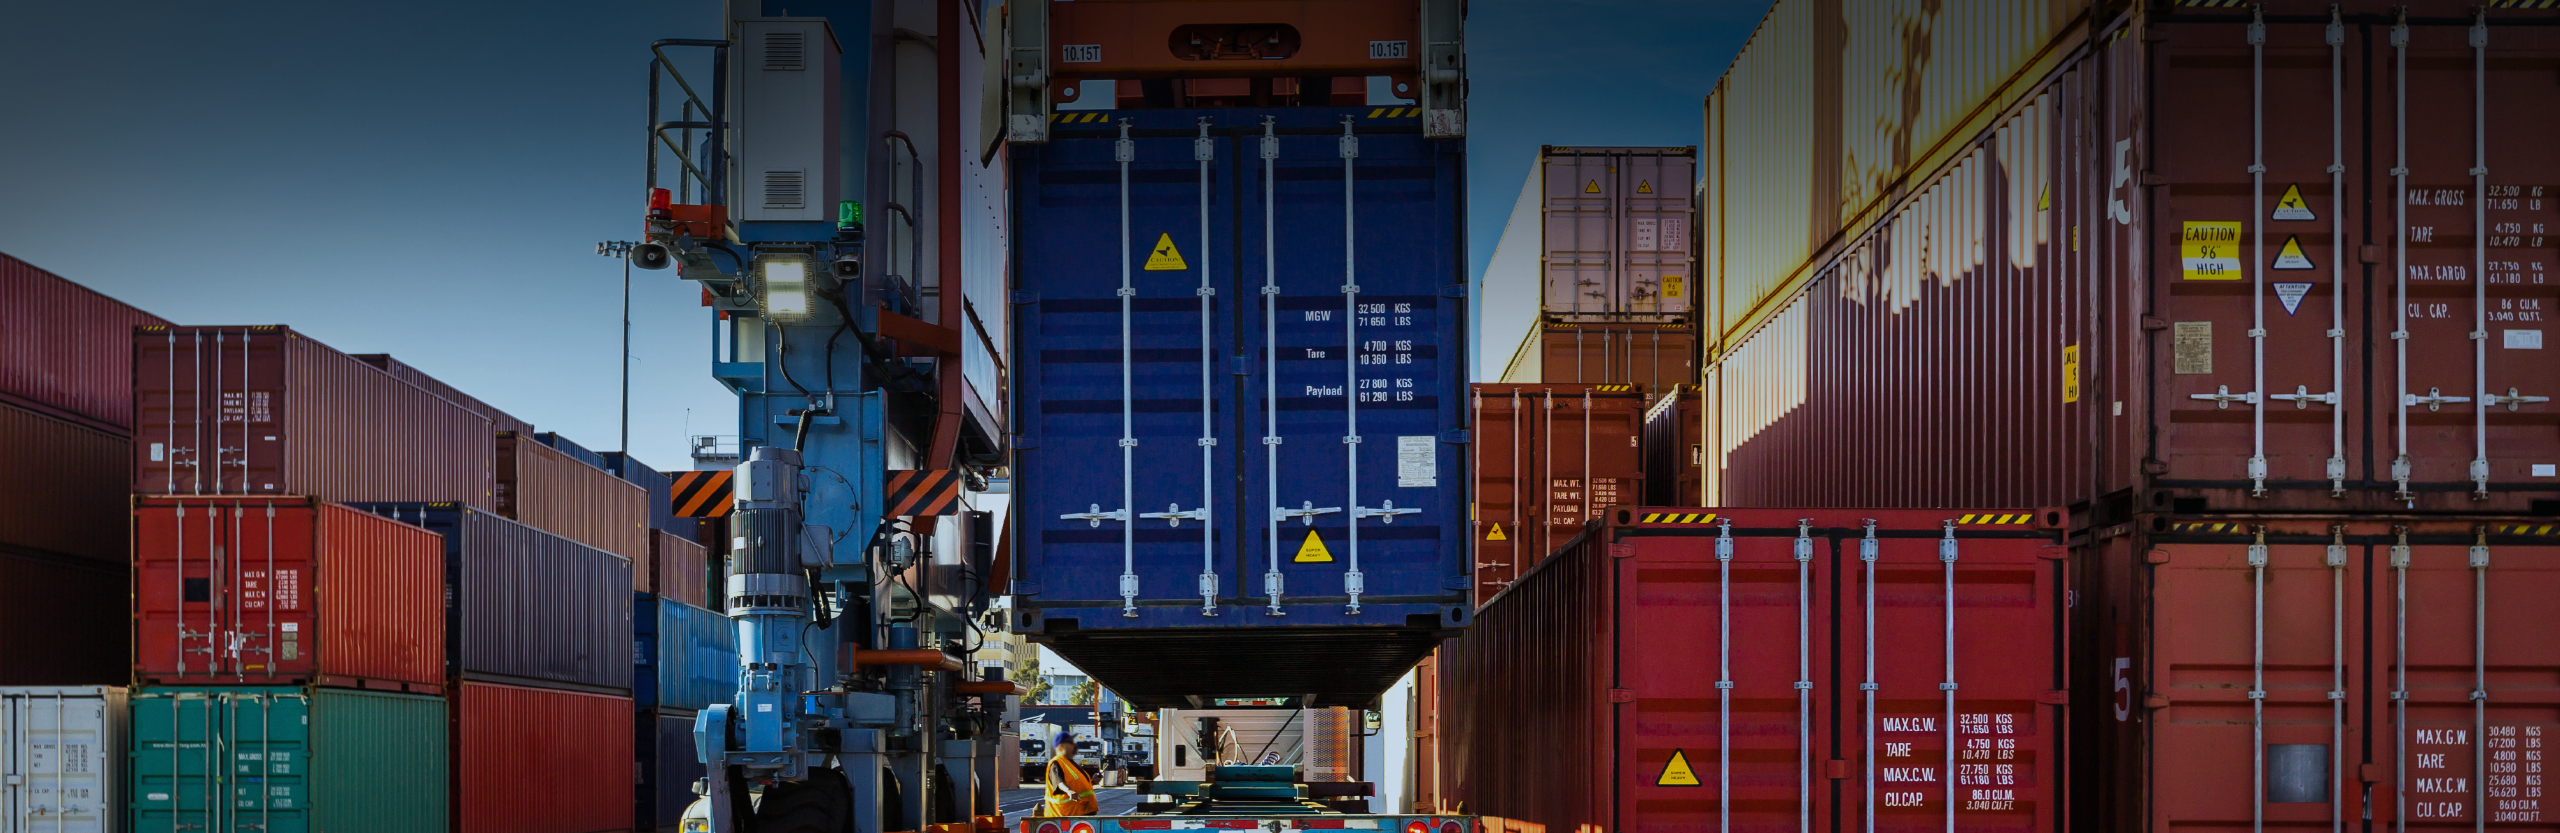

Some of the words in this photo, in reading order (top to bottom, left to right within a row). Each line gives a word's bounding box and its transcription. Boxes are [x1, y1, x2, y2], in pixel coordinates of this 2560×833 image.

[1064, 46, 1099, 60] 10.15T
[1371, 42, 1406, 57] 10.15T
[2488, 185, 2520, 197] 32.500
[2531, 186, 2543, 197] KG
[2408, 189, 2431, 205] MAX.
[2435, 189, 2465, 206] GROSS
[2487, 199, 2518, 210] 71.650
[2530, 199, 2541, 210] LB
[2186, 227, 2235, 241] CAUTION
[2411, 226, 2433, 242] TARE
[2495, 223, 2521, 234] 4.750
[2533, 223, 2544, 234] KG
[2489, 236, 2520, 247] 10.470
[2531, 236, 2543, 247] LB
[2197, 263, 2224, 275] HIGH
[2488, 261, 2519, 271] 27.750
[2531, 262, 2543, 271] KG
[2409, 265, 2433, 280] MAX.
[2436, 265, 2466, 281] CARGO
[2490, 273, 2521, 284] 61.180
[2533, 273, 2544, 284] LB
[1358, 304, 1368, 314] 32
[1370, 304, 1385, 314] 500
[1394, 303, 1411, 313] KGS
[2501, 299, 2512, 310] 86
[2519, 299, 2540, 310] CU.M.
[1305, 311, 1331, 321] MGW
[2408, 303, 2423, 318] CU.
[2429, 303, 2451, 318] CAP.
[1358, 317, 1368, 326] 71
[1370, 317, 1386, 326] 650
[1395, 317, 1411, 326] LBS
[2488, 312, 2514, 321] 3.040
[2518, 312, 2543, 321] CU.FT.
[1363, 341, 1369, 351] 4
[1372, 341, 1387, 351] 700
[1395, 340, 1412, 351] KGS
[1306, 349, 1326, 358] Tare
[1360, 354, 1369, 365] 10
[1372, 354, 1387, 365] 360
[1395, 354, 1412, 364] LBS
[1360, 379, 1370, 388] 27
[1372, 379, 1387, 388] 800
[1396, 378, 1413, 388] KGS
[1306, 385, 1342, 398] Payload
[1360, 392, 1370, 402] 61
[1372, 392, 1387, 402] 290
[1396, 391, 1413, 401] LBS
[1631, 436, 1637, 446] 5
[1554, 505, 1578, 513] PAYLOAD
[1564, 517, 1576, 525] CAP.
[245, 580, 257, 588] TARE
[1883, 717, 1936, 732] MAX.G.W.
[1960, 714, 1988, 724] 32.500
[1995, 714, 2013, 724] KGS
[1961, 725, 1989, 734] 71.650
[1996, 725, 2013, 734] LBS
[2488, 726, 2516, 737] 30.480
[2526, 726, 2541, 737] KGS
[2416, 729, 2468, 745] MAX.G.W.
[1967, 739, 1990, 749] 4.750
[1997, 739, 2015, 749] KGS
[2488, 738, 2516, 748] 67.200
[2526, 738, 2541, 748] LBS
[1885, 742, 1911, 757] TARE
[1962, 750, 1990, 760] 10.470
[1997, 750, 2014, 760] LBS
[2417, 753, 2445, 769] TARE
[2494, 751, 2516, 761] 4.800
[2526, 751, 2541, 761] KGS
[1960, 764, 1989, 774] 27.750
[1996, 764, 2013, 774] KGS
[2490, 762, 2516, 773] 10.580
[2526, 762, 2541, 773] LBS
[1884, 768, 1936, 782] MAX.C.W.
[1961, 775, 1989, 785] 61.180
[1997, 775, 2014, 785] LBS
[2489, 775, 2516, 785] 25.680
[2526, 775, 2541, 785] KGS
[2416, 778, 2468, 793] MAX.C.W.
[1972, 789, 1990, 800] 86.0
[1992, 789, 2015, 800] CU.M.
[2489, 787, 2516, 797] 56.620
[2526, 787, 2541, 797] LBS
[1885, 792, 1923, 807] CU.CAP.
[2499, 800, 2516, 810] 86.0
[1966, 801, 1989, 810] 3.040
[1991, 801, 2014, 810] CU.FT.
[2439, 802, 2462, 817] CAP.
[2495, 811, 2516, 822] 3.040
[2518, 811, 2541, 822] CU.FT.
